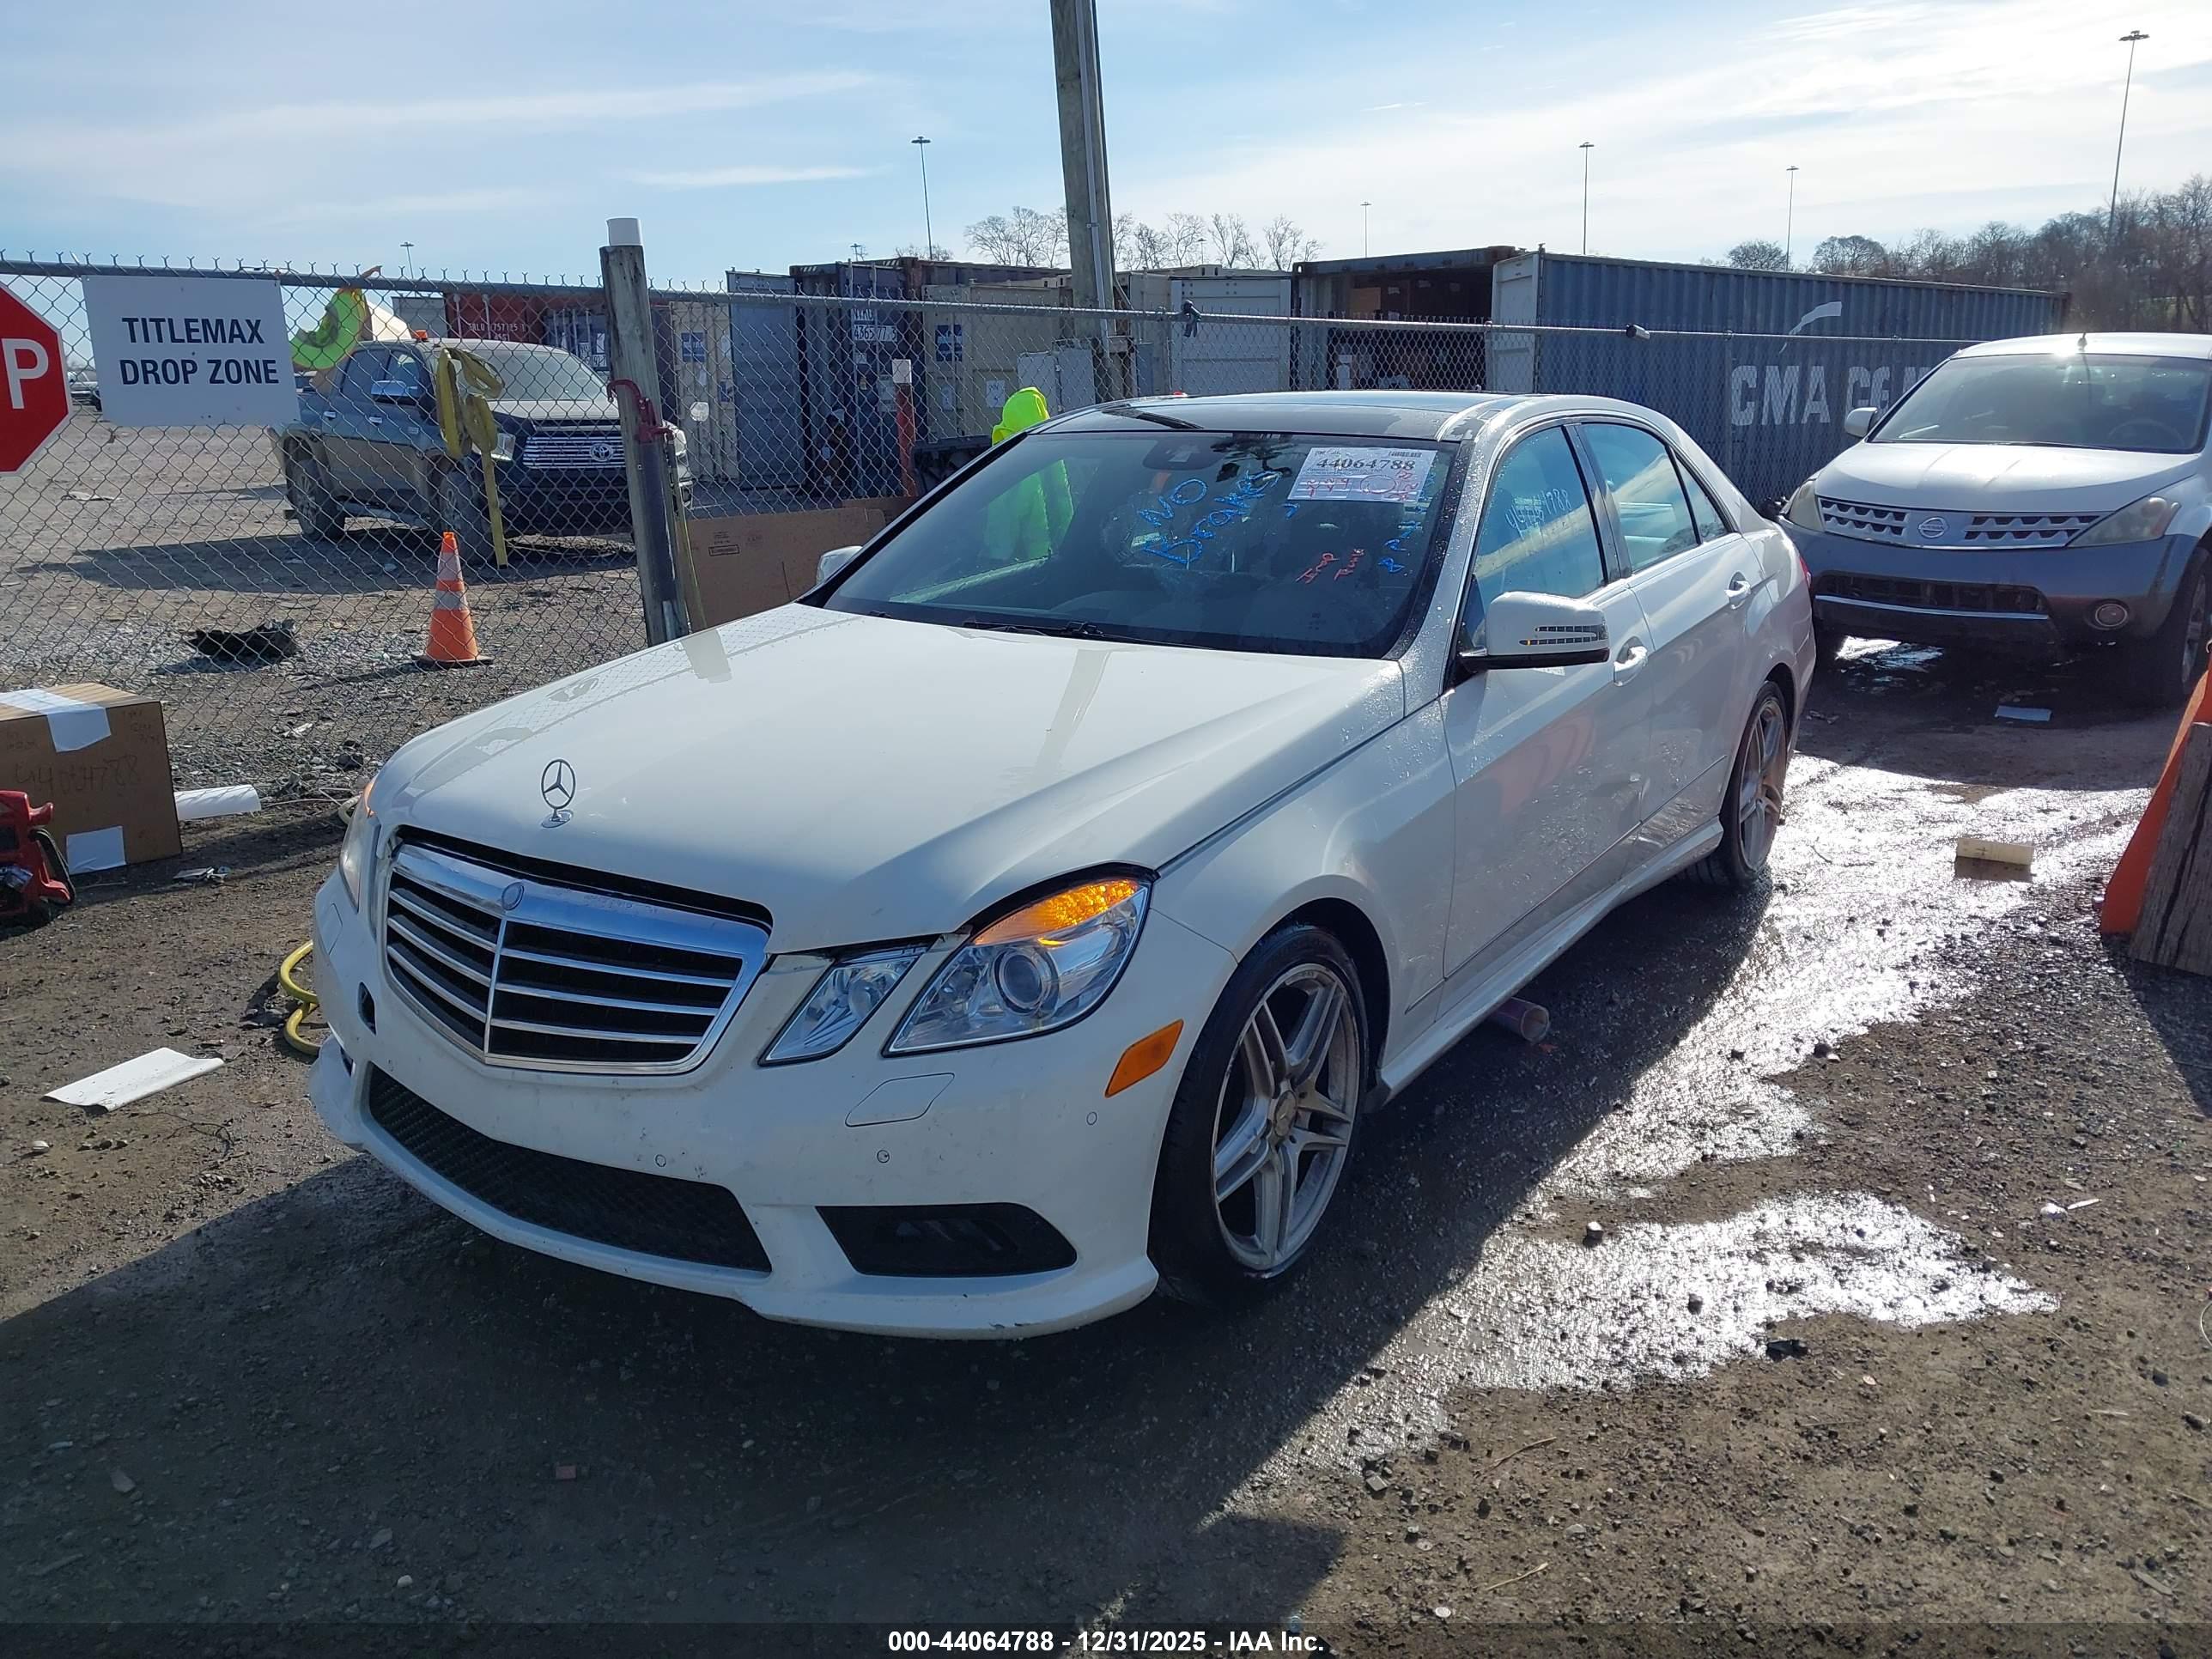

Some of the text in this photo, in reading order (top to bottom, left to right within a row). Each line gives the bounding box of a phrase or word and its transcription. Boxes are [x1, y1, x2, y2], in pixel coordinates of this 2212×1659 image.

[122, 318, 265, 343] TITLEMAX
[120, 359, 280, 385] DROP ZONE
[1731, 365, 1831, 426] CMA
[1317, 459, 1416, 471] 44064788
[1137, 478, 1206, 526] NO
